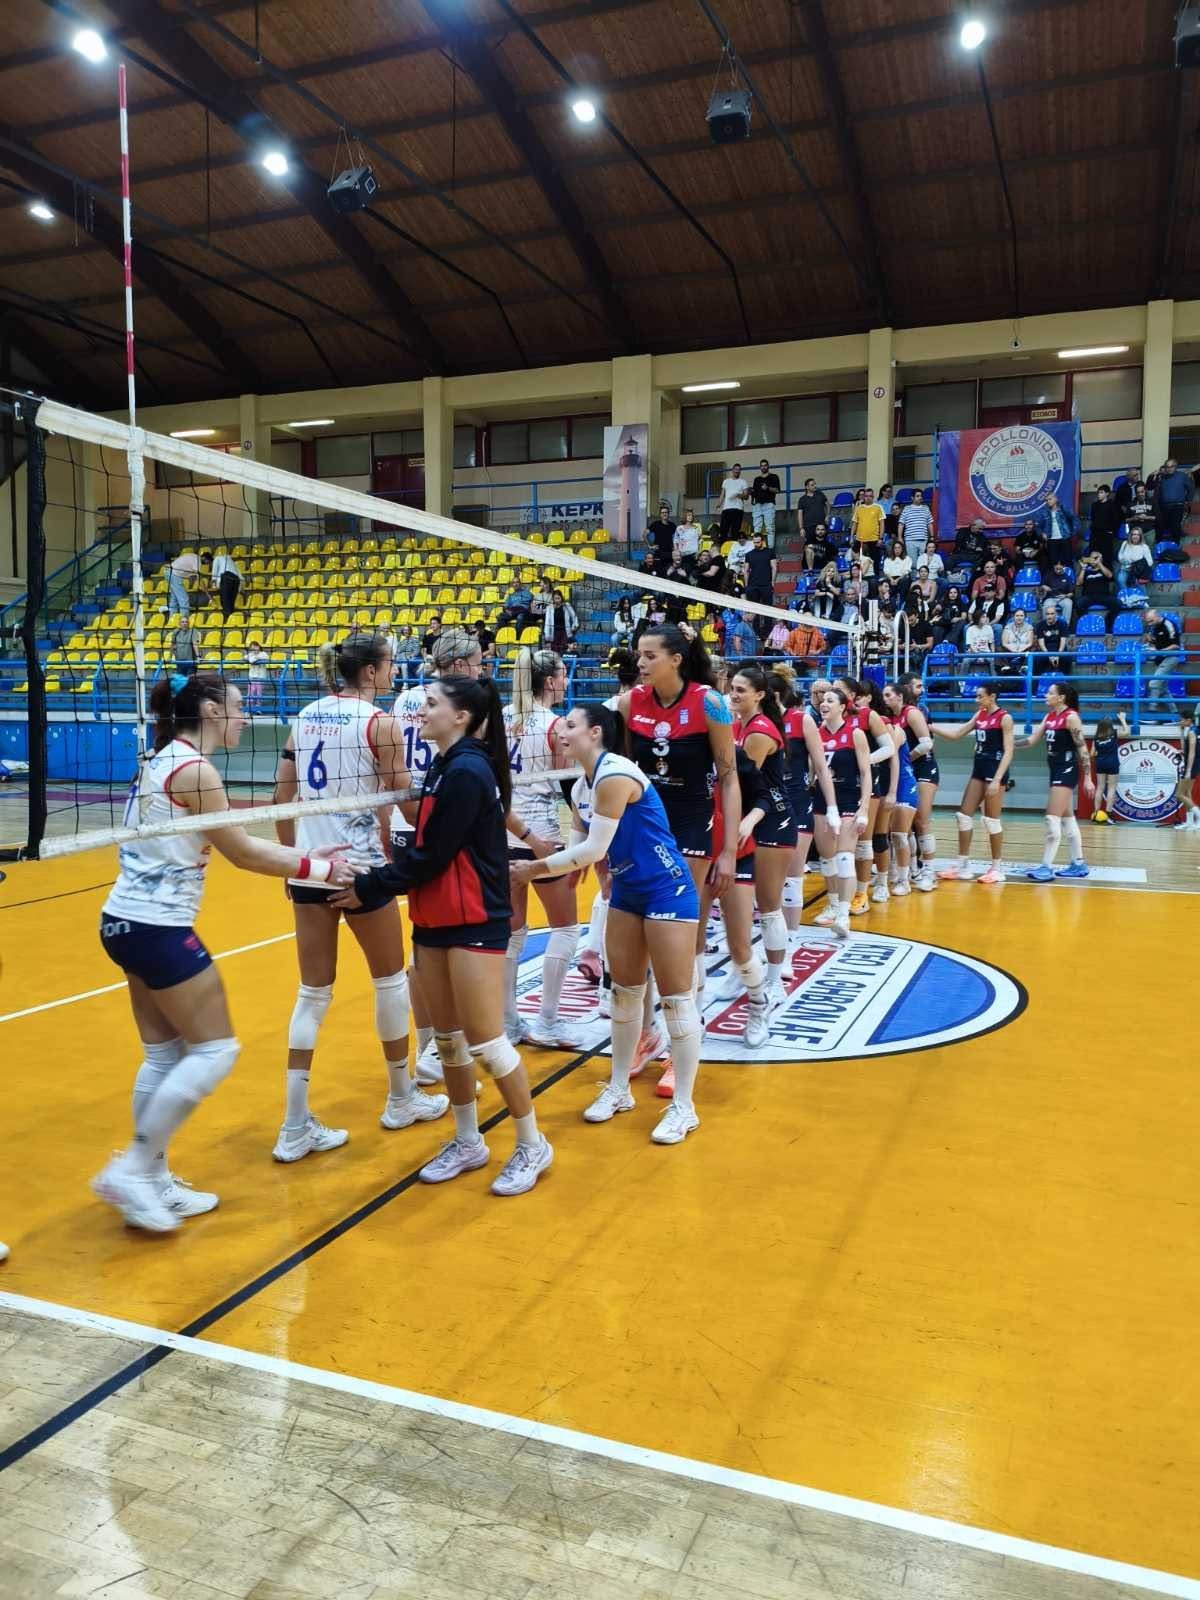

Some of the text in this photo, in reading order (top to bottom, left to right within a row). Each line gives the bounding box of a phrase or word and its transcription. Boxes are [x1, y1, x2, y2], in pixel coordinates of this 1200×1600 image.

[976, 429, 1059, 466] APOLLONIOS
[632, 714, 656, 725] Zeus
[404, 727, 432, 771] 15
[652, 737, 670, 757] 3
[1045, 730, 1056, 742] 22
[307, 741, 328, 791] 6
[837, 942, 900, 967] ΚΤΕΟ
[781, 978, 867, 1024] ΘΗΒΩΝ
